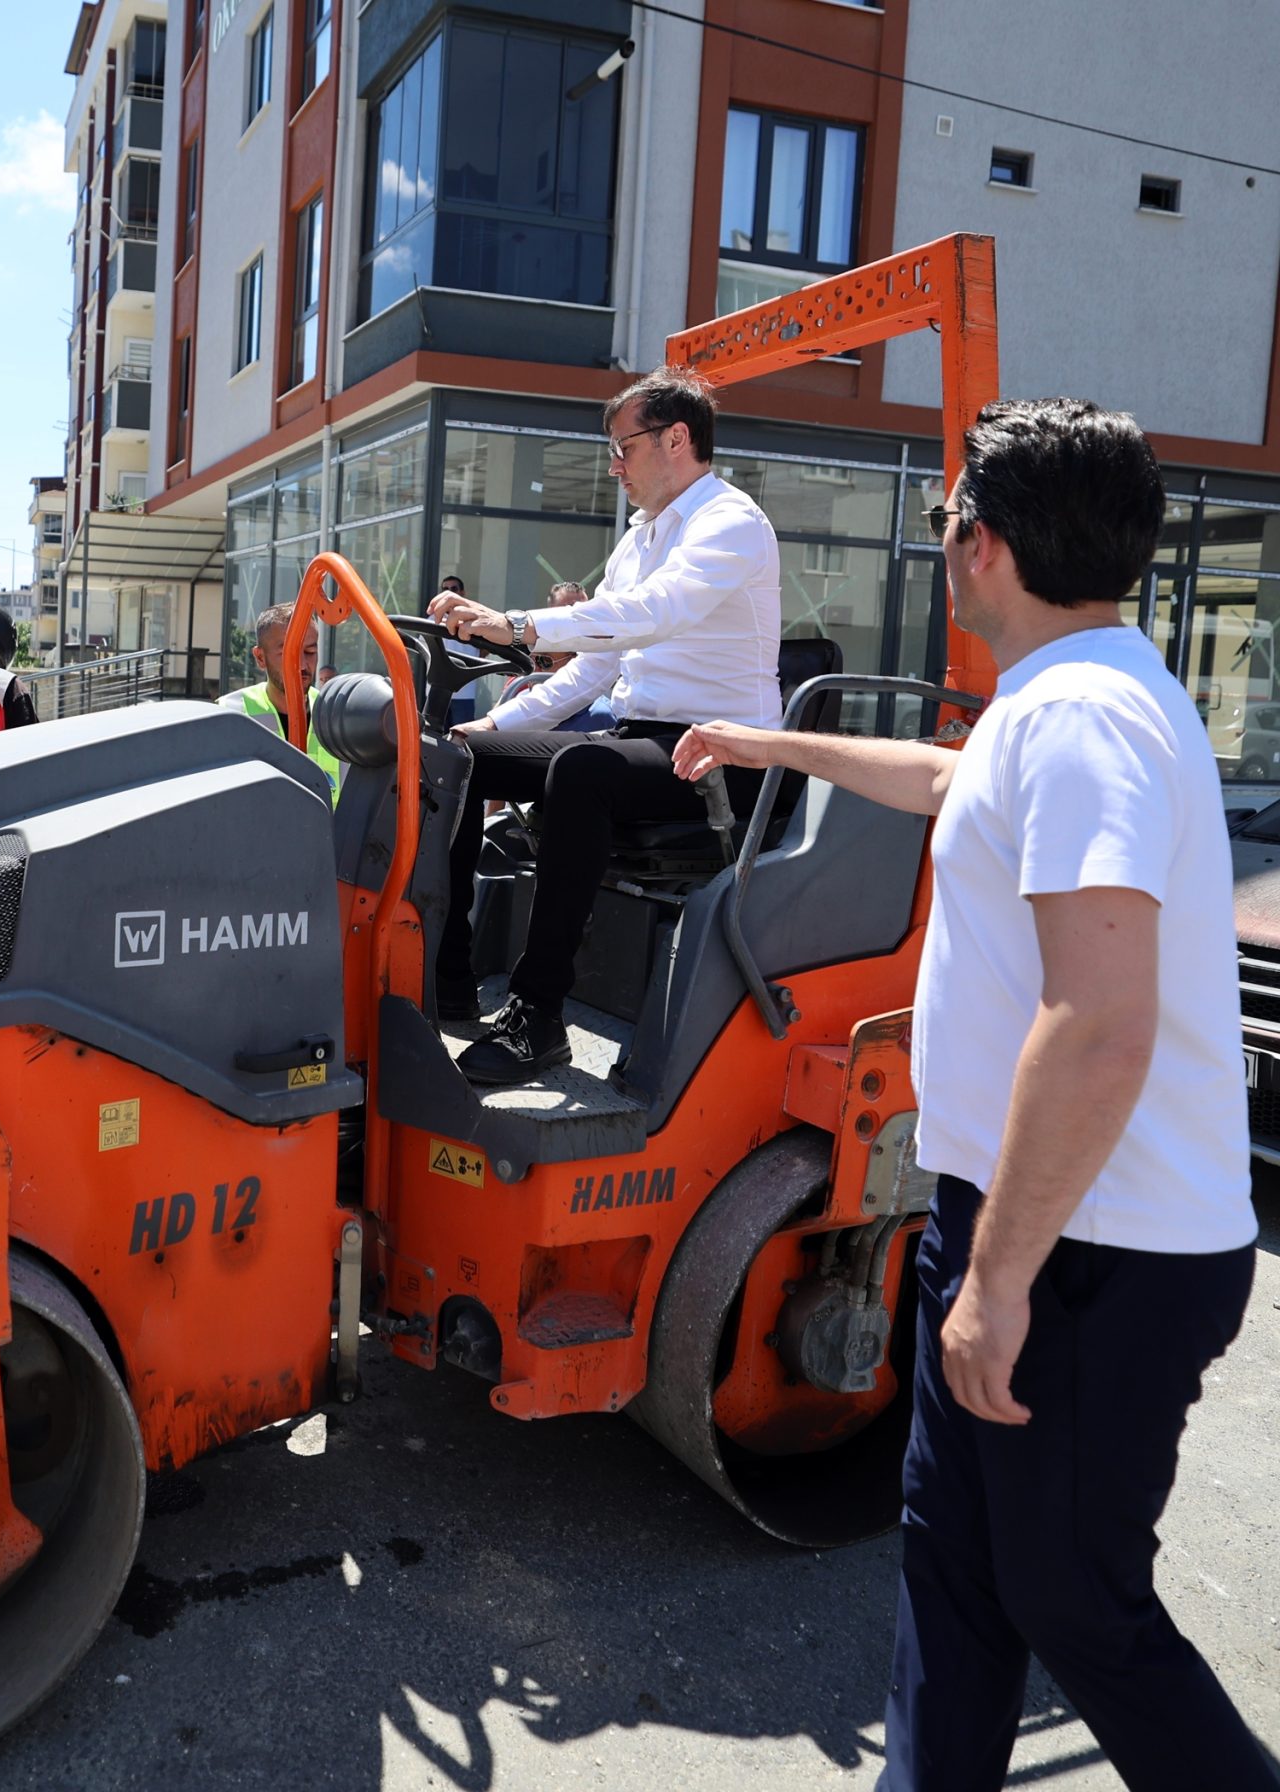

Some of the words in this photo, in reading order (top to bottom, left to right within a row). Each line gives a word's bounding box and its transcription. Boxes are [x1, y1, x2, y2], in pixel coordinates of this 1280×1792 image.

[181, 911, 309, 954] HAMM
[569, 1166, 676, 1214] HAMM
[128, 1192, 196, 1256] HD
[211, 1175, 262, 1235] 12
